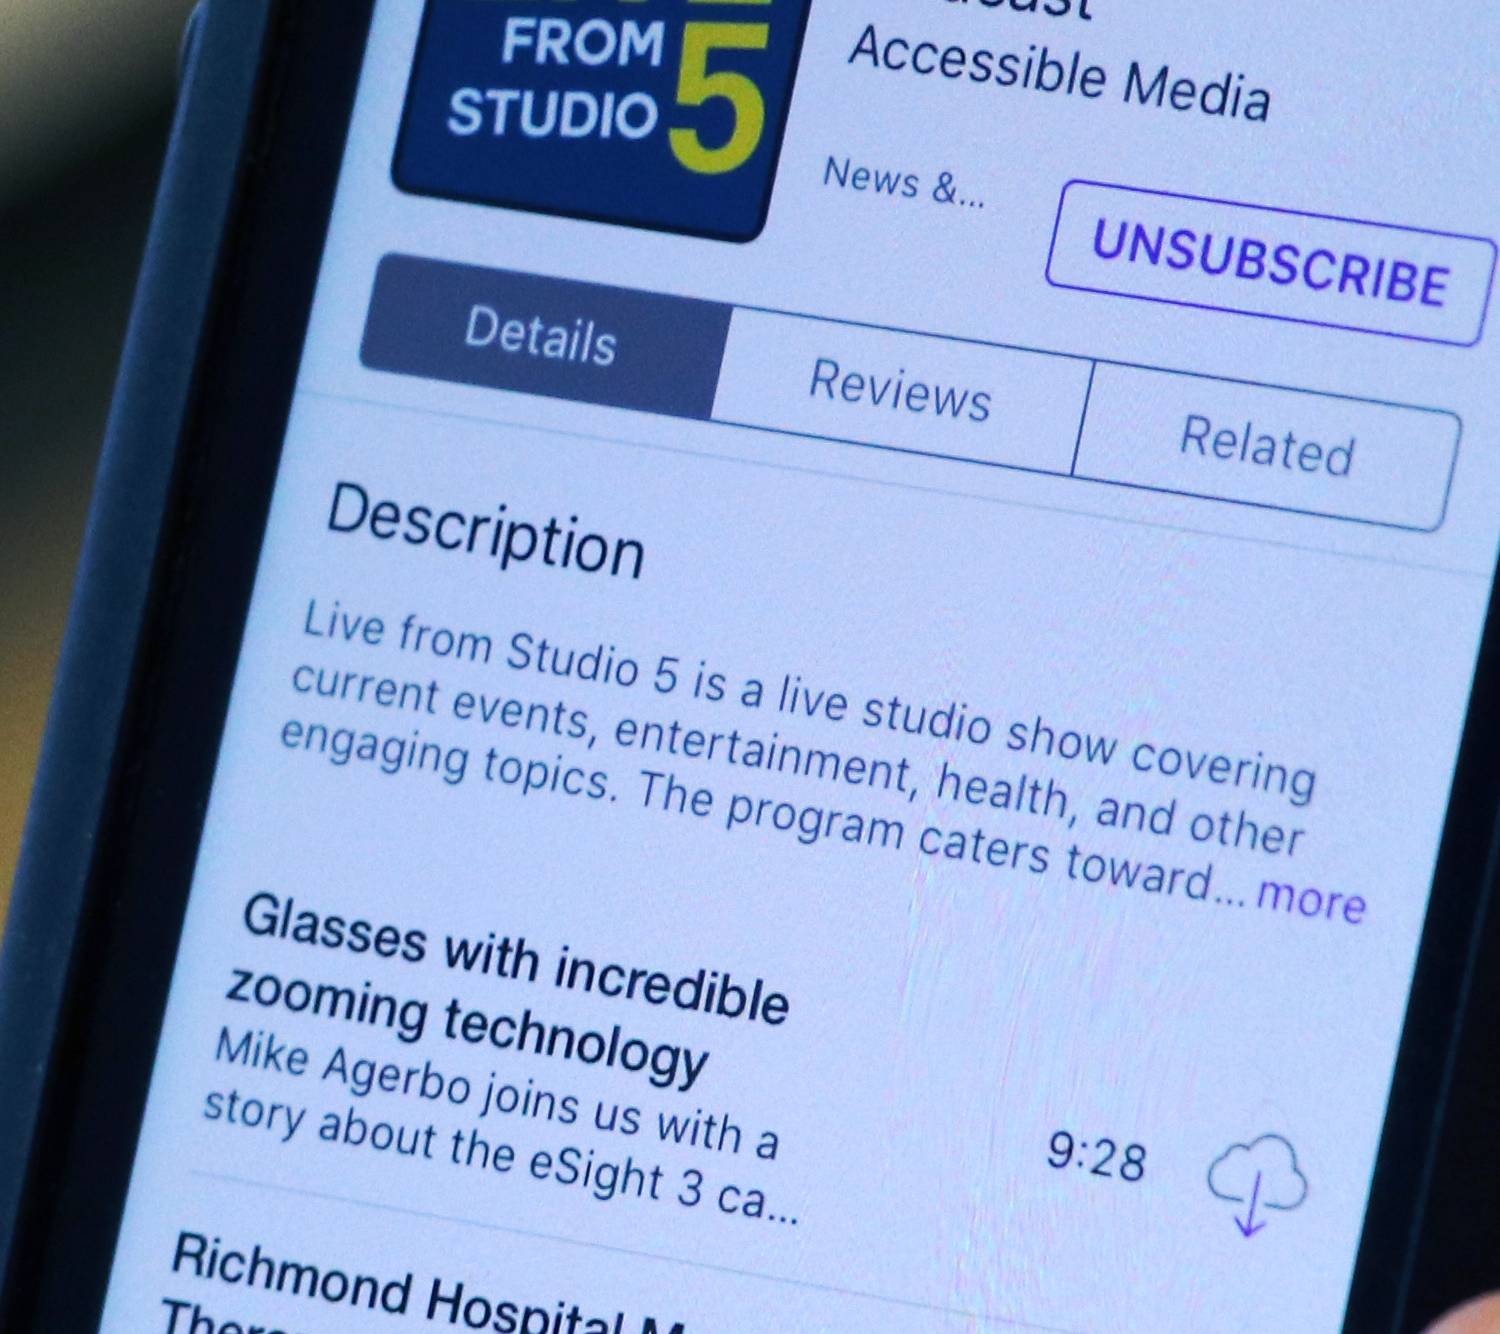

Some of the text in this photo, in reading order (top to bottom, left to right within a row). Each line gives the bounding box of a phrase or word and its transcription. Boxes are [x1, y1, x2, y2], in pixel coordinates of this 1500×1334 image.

[501, 15, 666, 68] FROM
[846, 22, 1272, 124] Accessible Media
[446, 86, 660, 141] STUDIO
[667, 20, 771, 176] 5
[822, 154, 920, 200] News
[1092, 216, 1451, 309] UNSUBSCRIBE
[464, 303, 618, 367] Details
[808, 356, 993, 424] Reviews
[1179, 412, 1357, 478] Related
[326, 480, 645, 581] Description
[302, 597, 1318, 809] Live from Studio 5 is a live studio show covering
[291, 663, 1307, 858] current events, entertainment, health, and other
[279, 718, 470, 787] engaging
[483, 746, 618, 803] topics.
[639, 768, 715, 819] The
[724, 793, 905, 851] program
[918, 825, 1051, 875] caters
[1255, 880, 1368, 926] more
[242, 890, 791, 1027] Glasses with incredible
[224, 968, 711, 1094] zooming technology
[214, 1024, 780, 1162] Mike Agerbo joins us with a
[202, 1088, 308, 1144] story
[318, 1105, 438, 1160] about
[450, 1127, 516, 1174] the
[528, 1145, 665, 1203] eSight
[676, 1167, 705, 1209] 3
[1046, 1129, 1148, 1184] 9:28
[171, 1229, 414, 1316] Richmond
